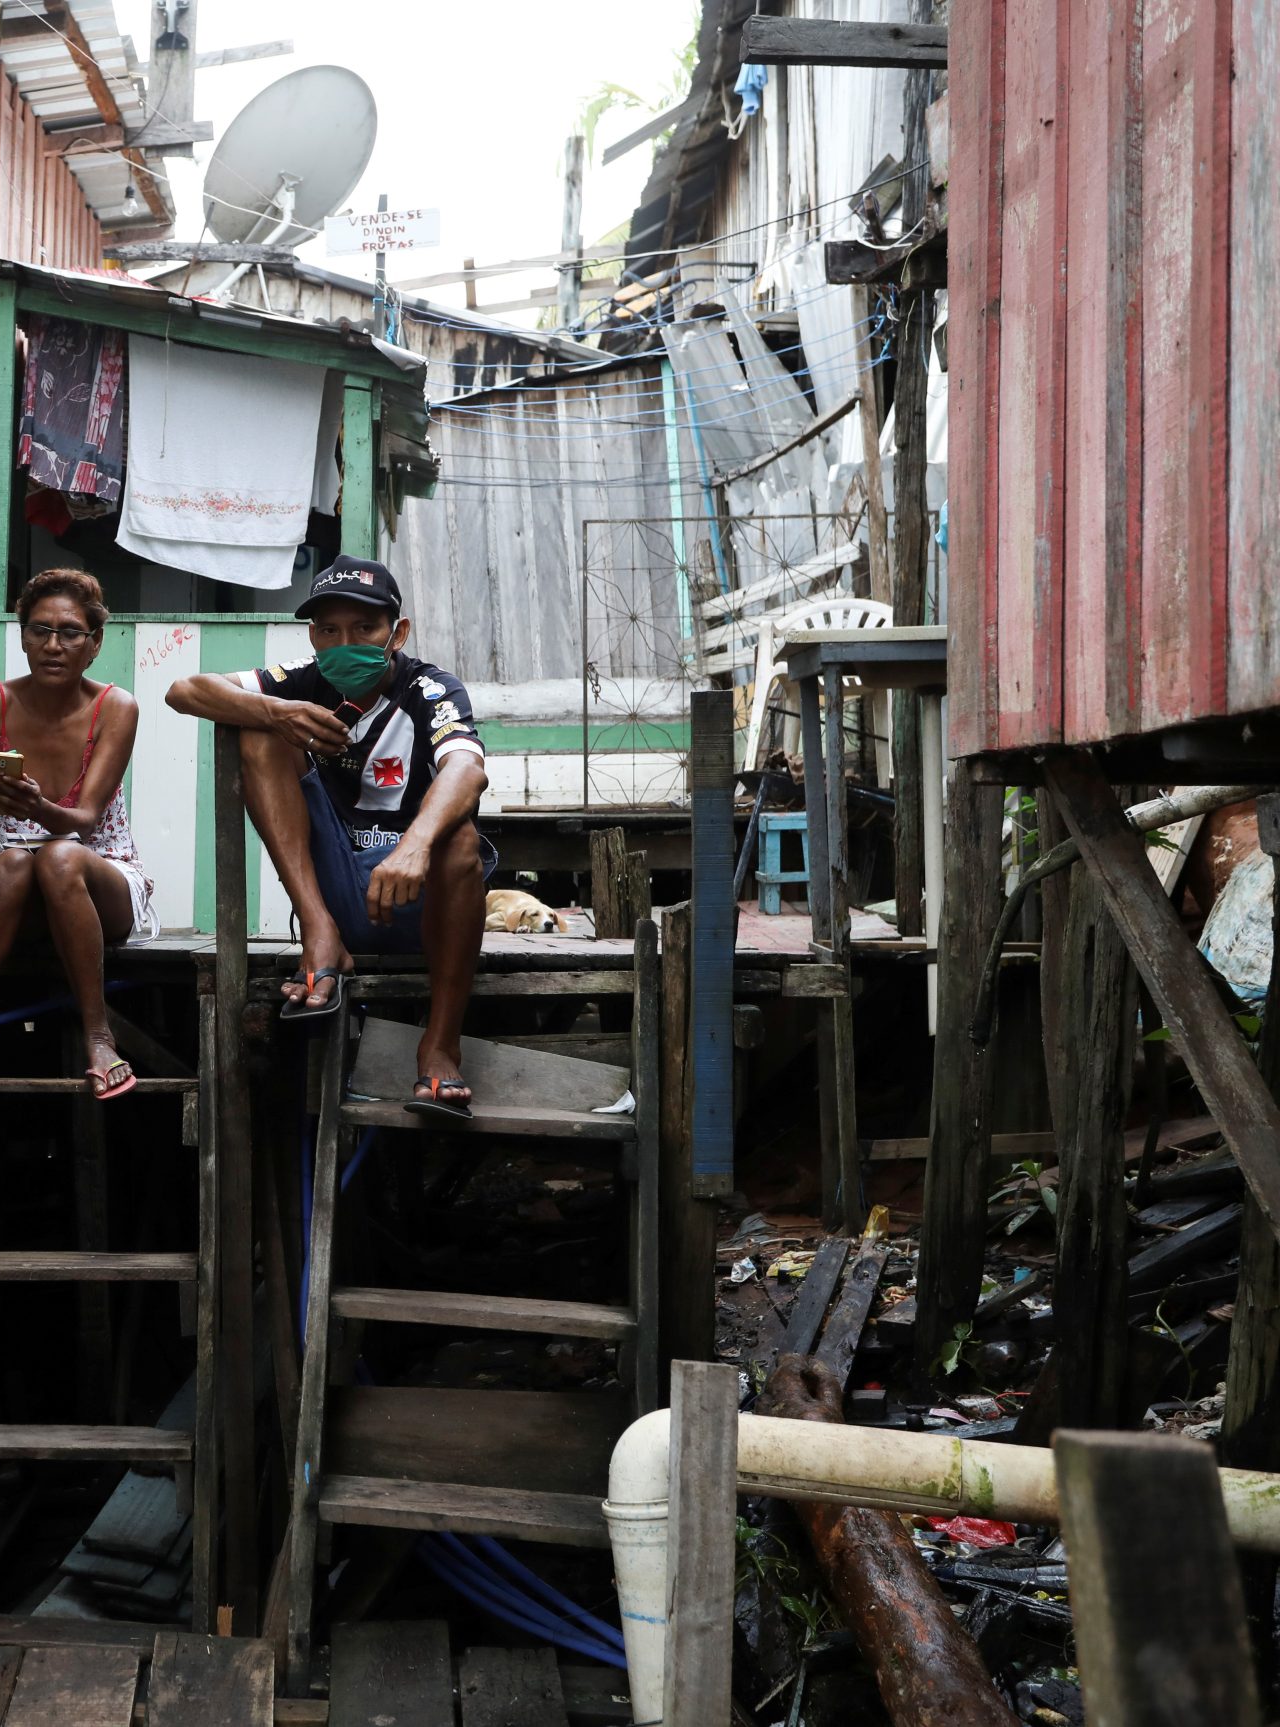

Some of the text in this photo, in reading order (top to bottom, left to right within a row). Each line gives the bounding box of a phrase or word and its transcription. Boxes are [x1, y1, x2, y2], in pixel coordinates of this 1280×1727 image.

[348, 209, 423, 227] VENDE-SE
[362, 239, 414, 252] FRUTAS
[378, 235, 392, 243] DE
[350, 824, 405, 849] robra
